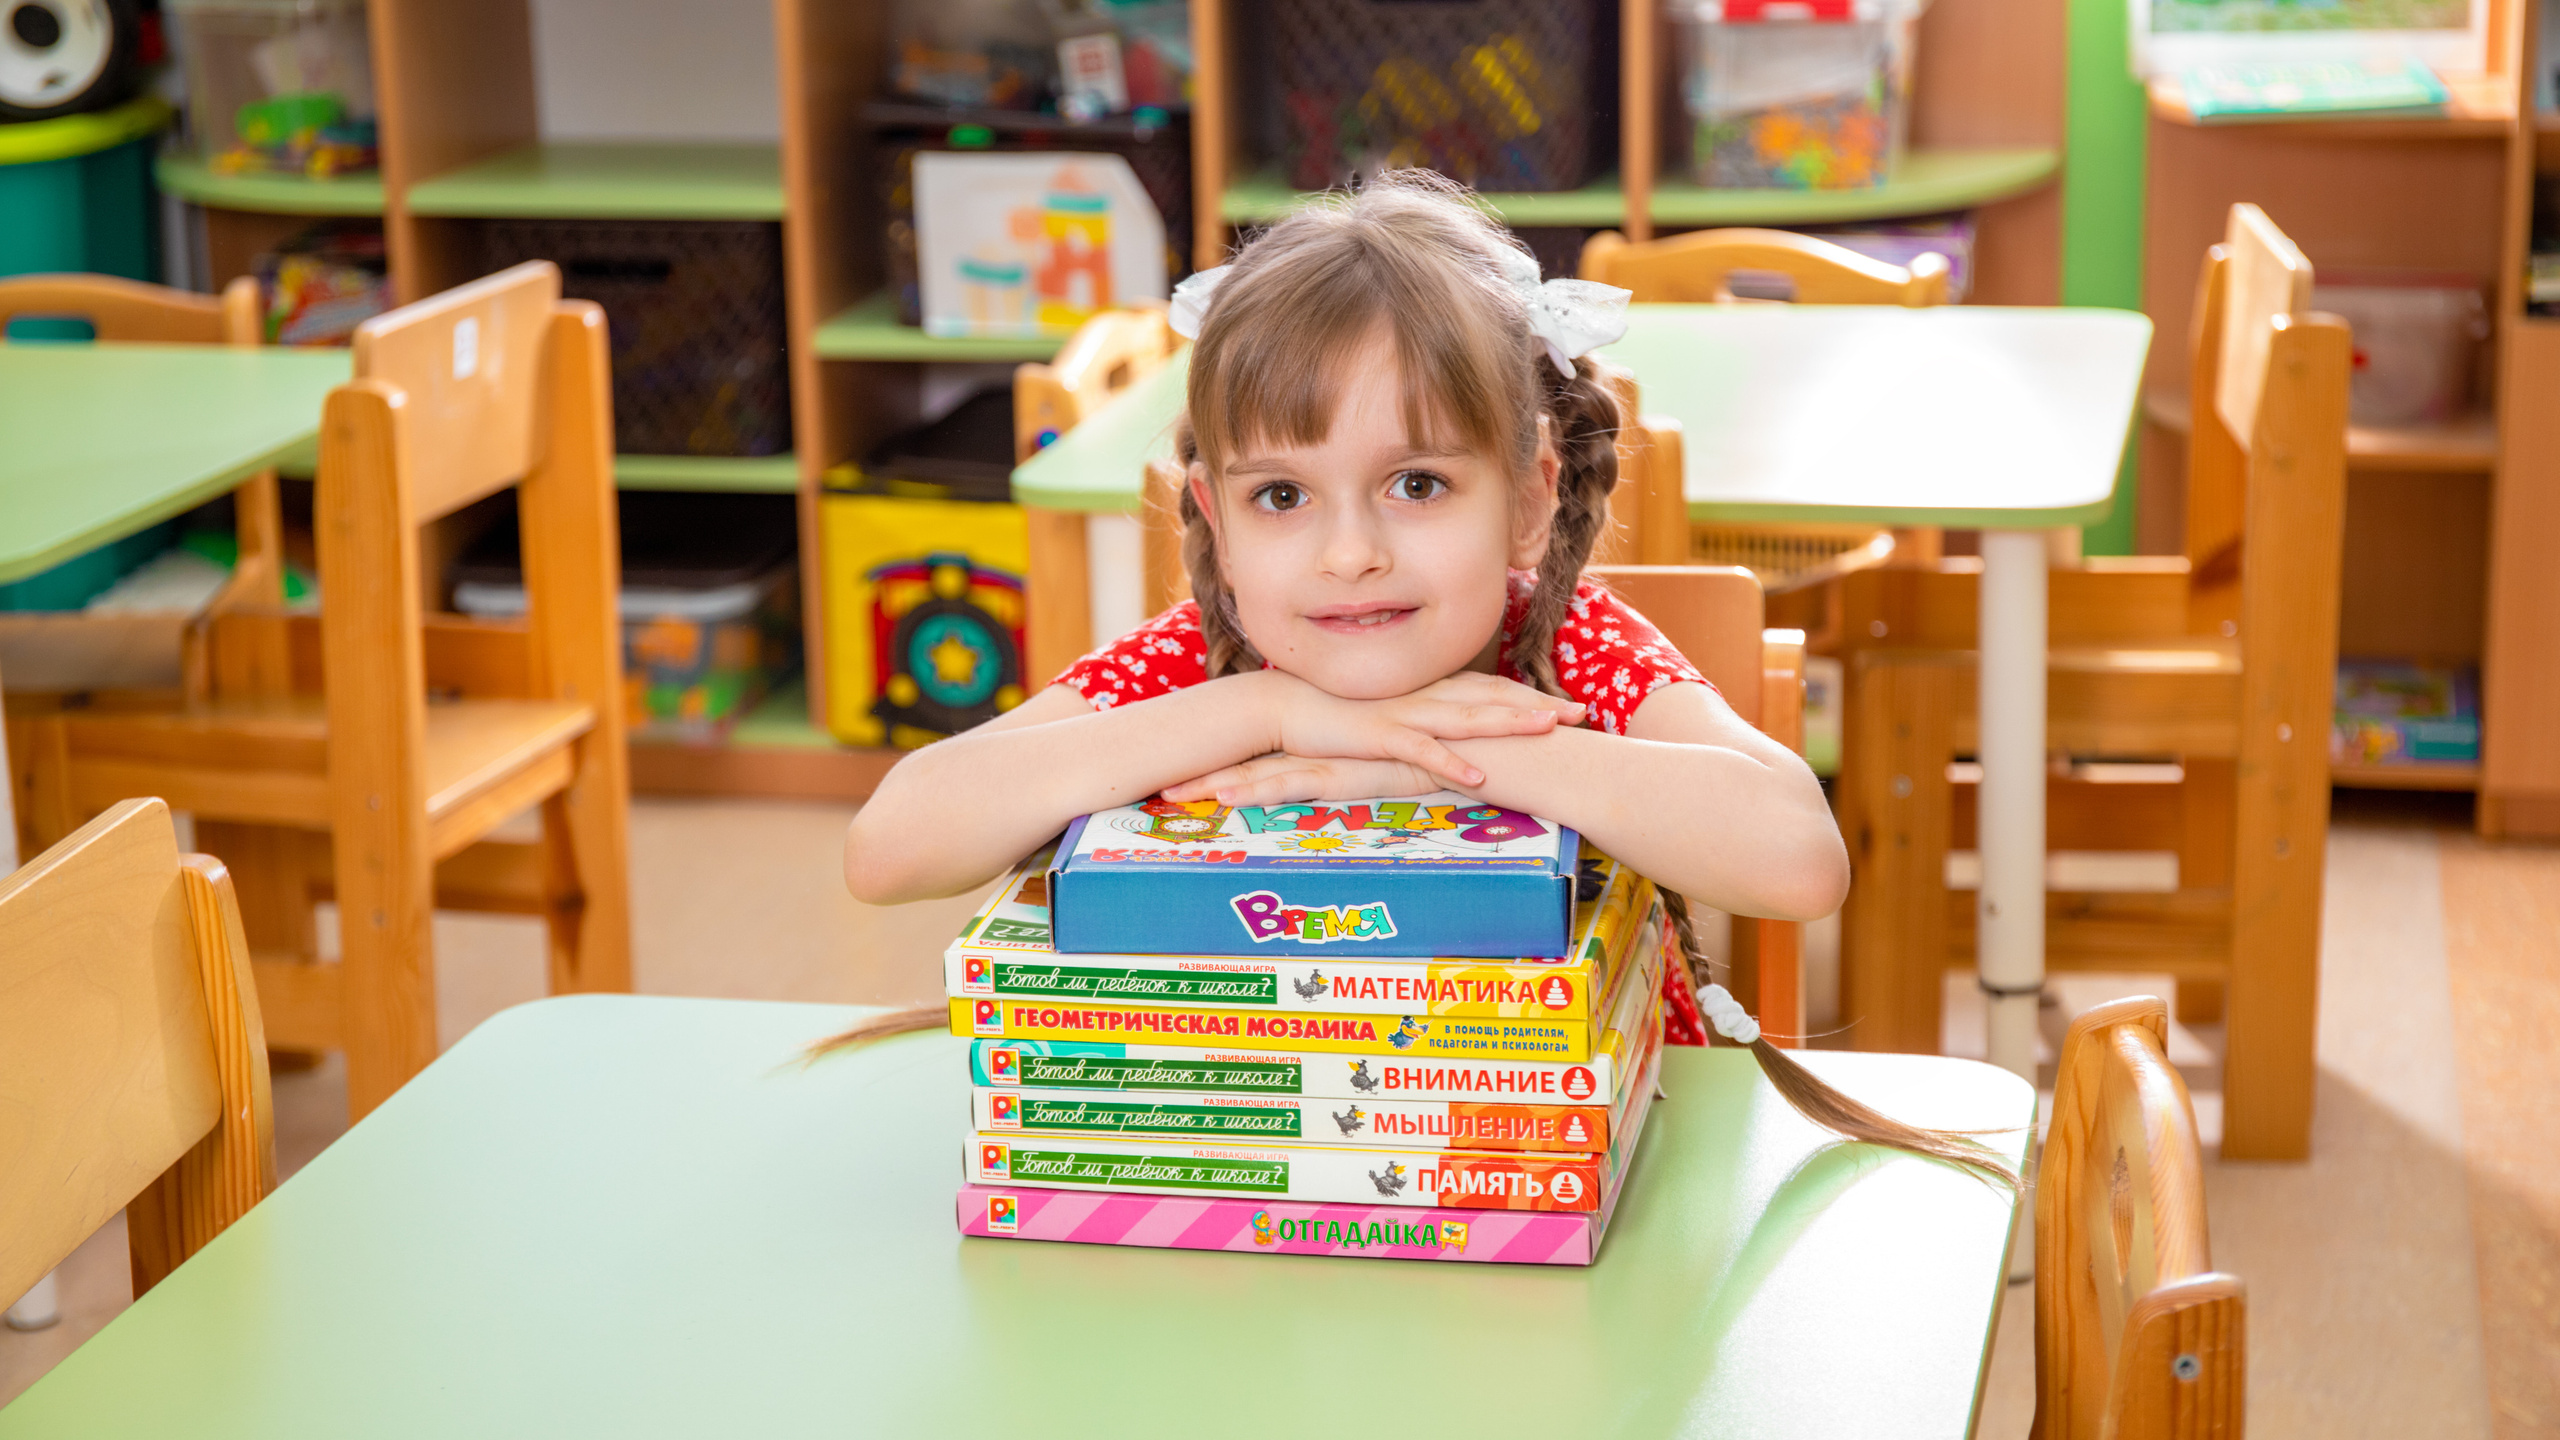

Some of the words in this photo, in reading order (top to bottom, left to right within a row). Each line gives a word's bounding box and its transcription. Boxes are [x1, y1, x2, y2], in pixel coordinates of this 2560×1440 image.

[1002, 966, 1060, 988] Готов
[1064, 977, 1088, 989] ли
[1177, 981, 1192, 993] к
[1198, 977, 1271, 996] школе?
[1179, 963, 1250, 973] РАЗВИВАЮЩАЯ
[1253, 965, 1276, 973] ИГРА
[1333, 976, 1537, 1003] МАТЕМАТИКА
[1013, 1008, 1240, 1036] ГЕОМЕТРИЧЕСКАЯ
[1246, 1018, 1377, 1041] МОЗАИКА
[1455, 1025, 1500, 1037] помощь
[1503, 1027, 1569, 1040] родителям,
[1429, 1038, 1488, 1049] педагогам
[1491, 1040, 1498, 1049] и
[1502, 1041, 1570, 1052] психологам
[1027, 1058, 1086, 1080] Готов
[1089, 1068, 1114, 1081] ли
[1203, 1072, 1218, 1084] к
[1224, 1068, 1295, 1086] школе?
[1205, 1054, 1276, 1064] РАЗВИВАЮЩАЯ
[1384, 1067, 1555, 1093] ВНИМАНИЕ
[1028, 1102, 1085, 1123] Готов
[1090, 1111, 1114, 1124] ли
[1203, 1115, 1217, 1127] к
[1223, 1112, 1295, 1130] школе?
[1204, 1099, 1274, 1108] РАЗВИВАЮЩАЯ
[1278, 1101, 1300, 1109] ИГРА
[1374, 1113, 1555, 1141] МЫШЛЕНИЕ
[1017, 1152, 1073, 1174] Готов
[1078, 1161, 1102, 1175] ли
[1191, 1166, 1206, 1179] к
[1212, 1166, 1284, 1184] школе?
[1193, 1150, 1263, 1160] РАЗВИВАЮЩАЯ
[1267, 1153, 1290, 1161] ИГРА
[1418, 1169, 1544, 1197] ПАМЯТЬ
[1279, 1218, 1437, 1247] ОТГАДАЙКА
